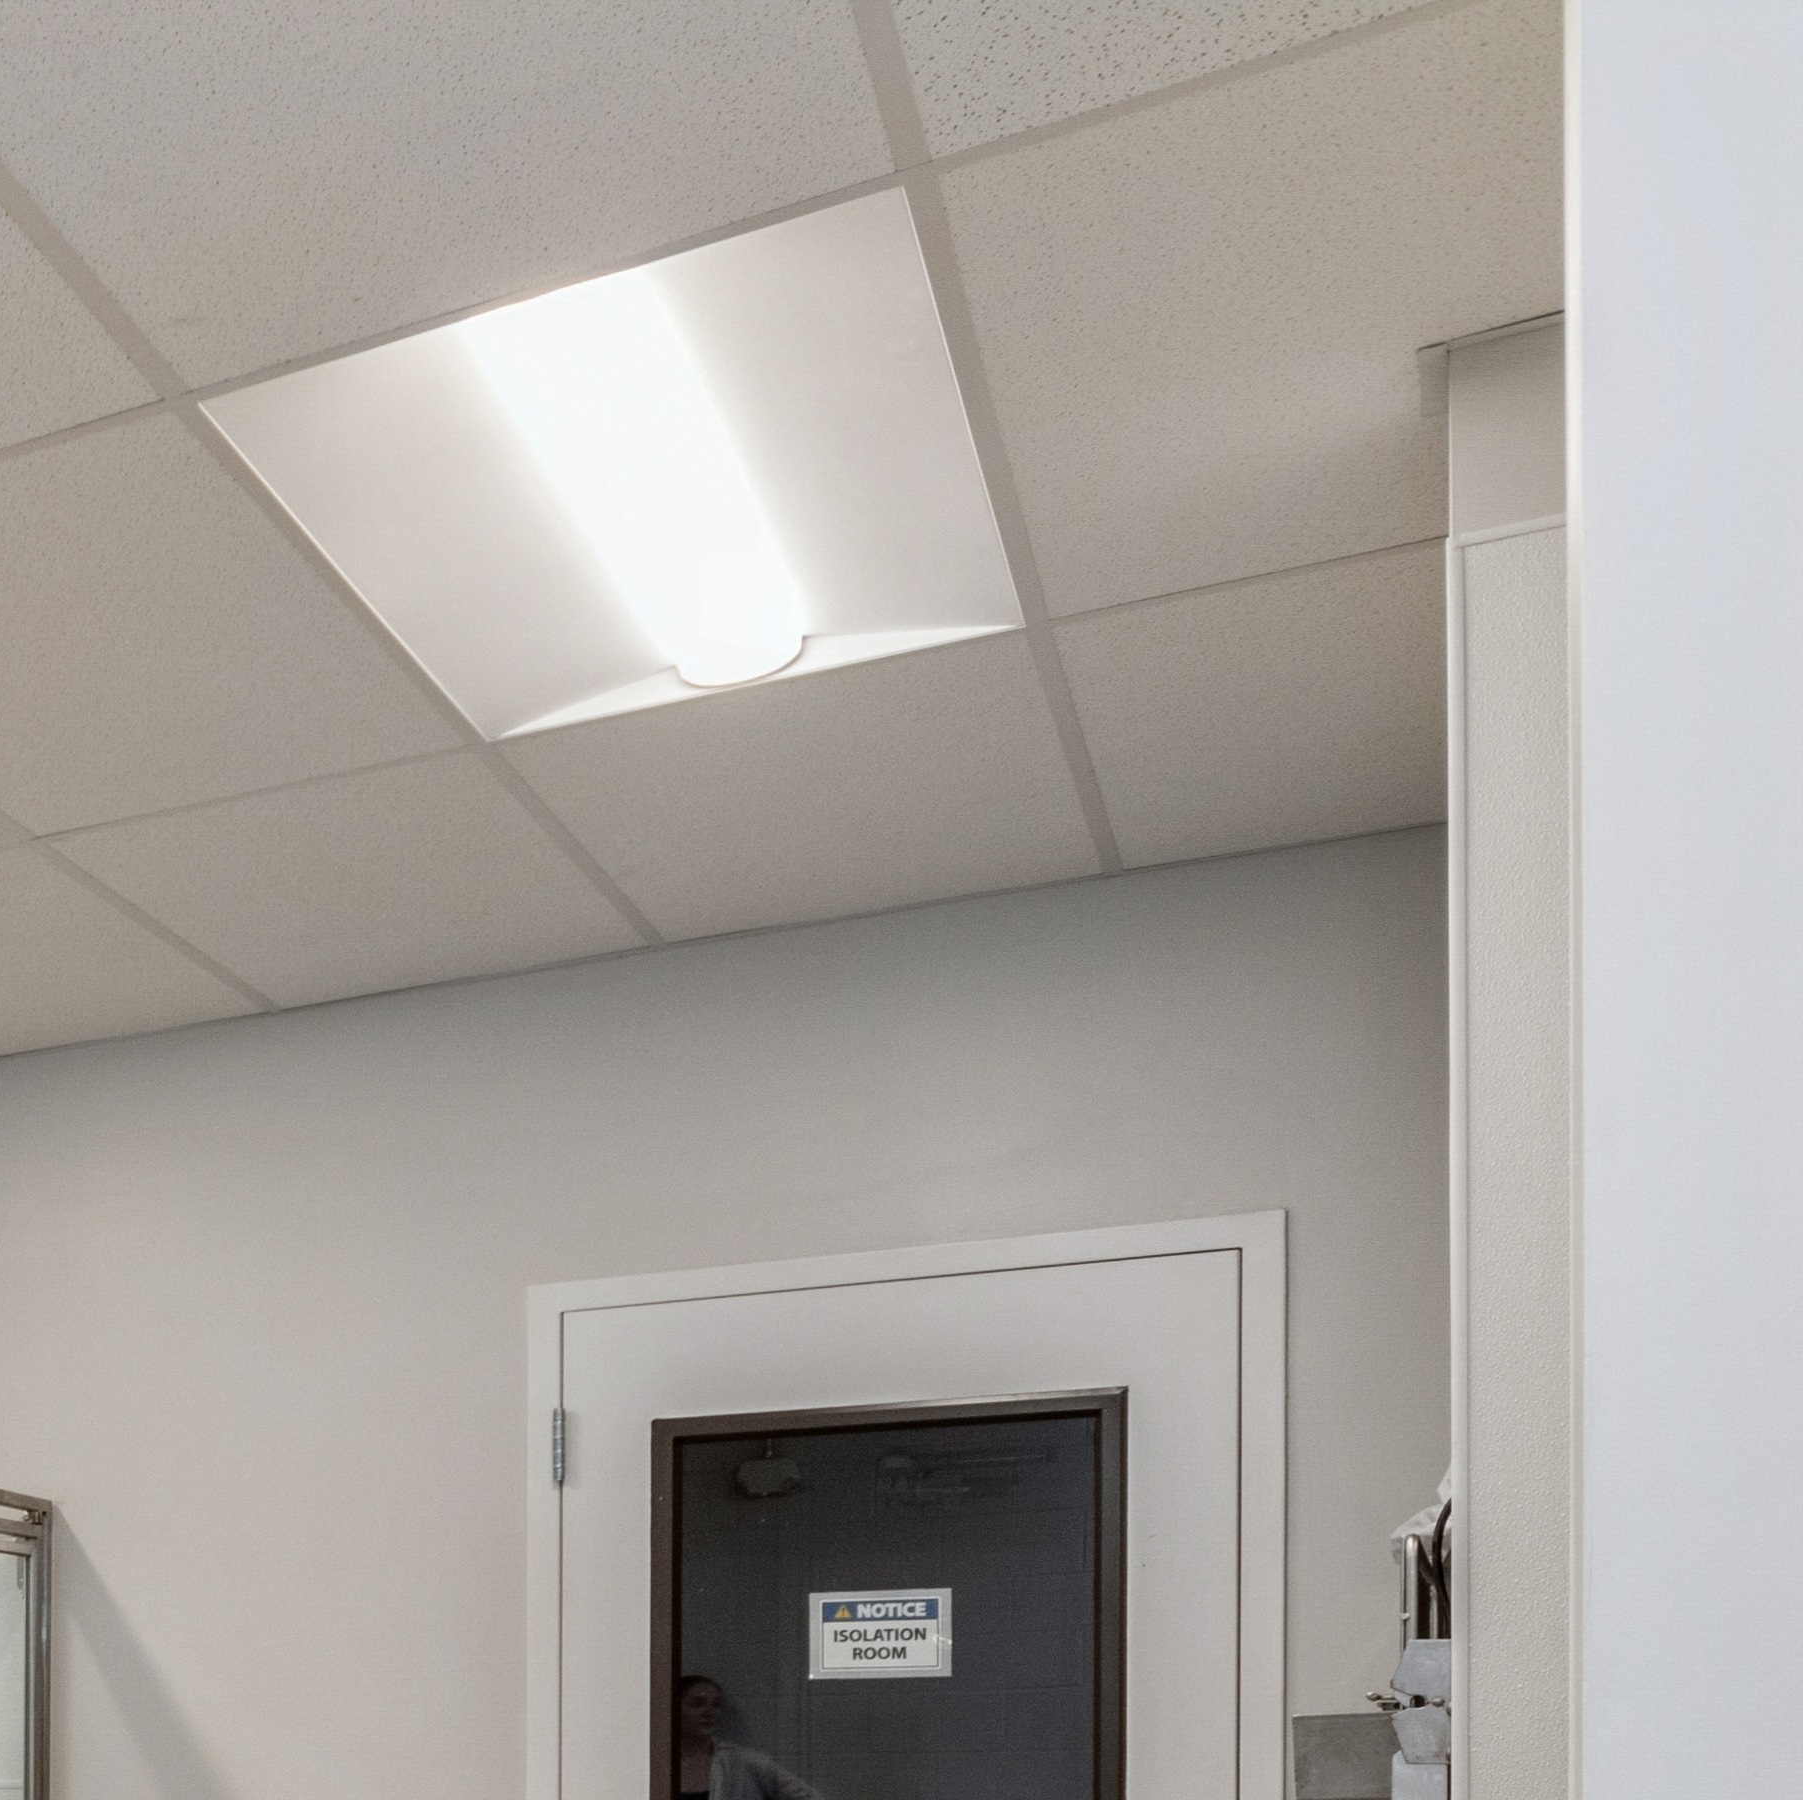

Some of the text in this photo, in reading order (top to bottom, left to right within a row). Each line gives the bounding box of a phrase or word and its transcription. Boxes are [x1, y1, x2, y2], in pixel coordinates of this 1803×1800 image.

[856, 1602, 927, 1619] NOTICE
[833, 1627, 927, 1643] ISOLATION
[852, 1646, 907, 1660] ROOM
